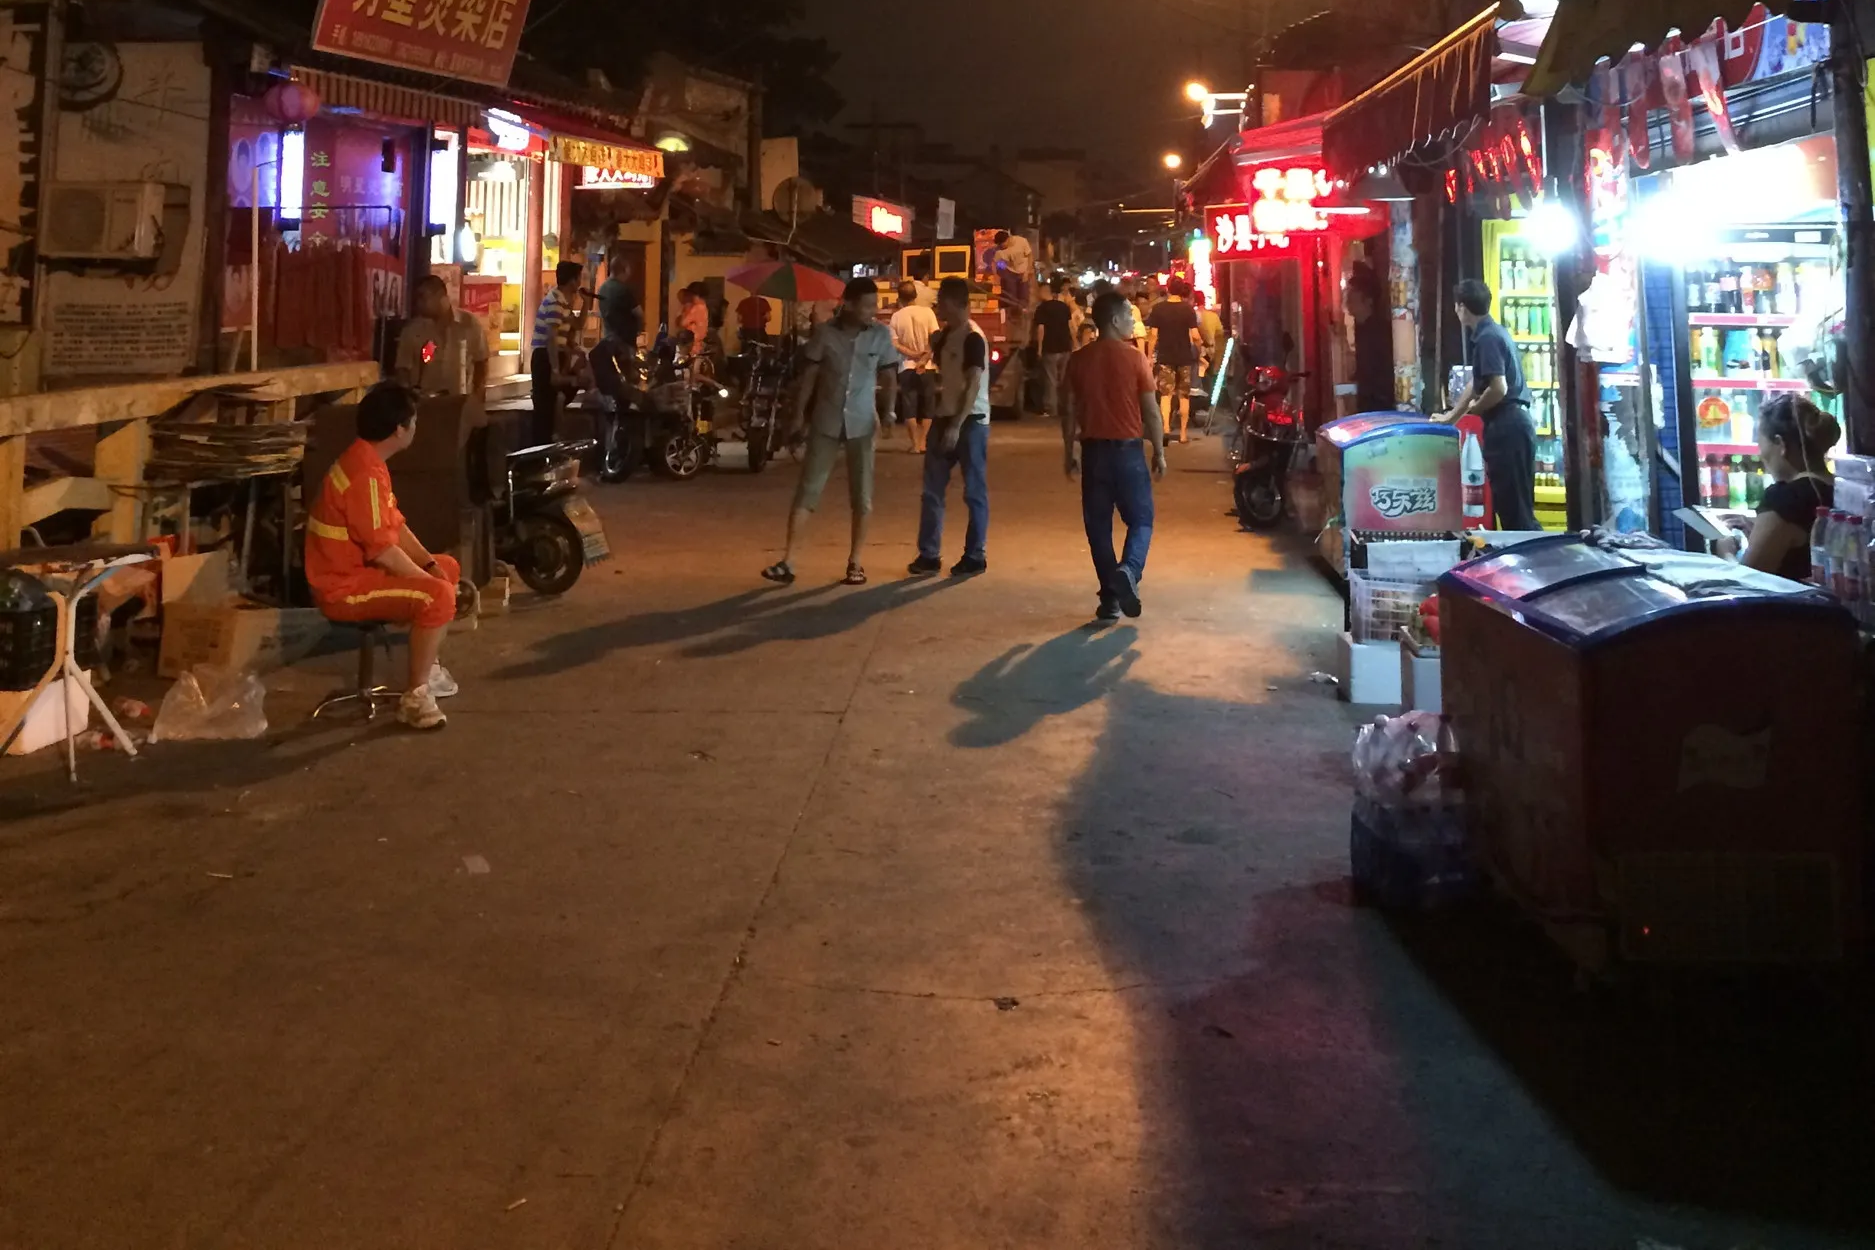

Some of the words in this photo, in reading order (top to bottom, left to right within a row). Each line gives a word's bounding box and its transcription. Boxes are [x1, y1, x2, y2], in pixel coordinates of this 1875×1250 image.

[307, 150, 331, 248] 注意安全
[1369, 485, 1437, 518] 巧乐兹
